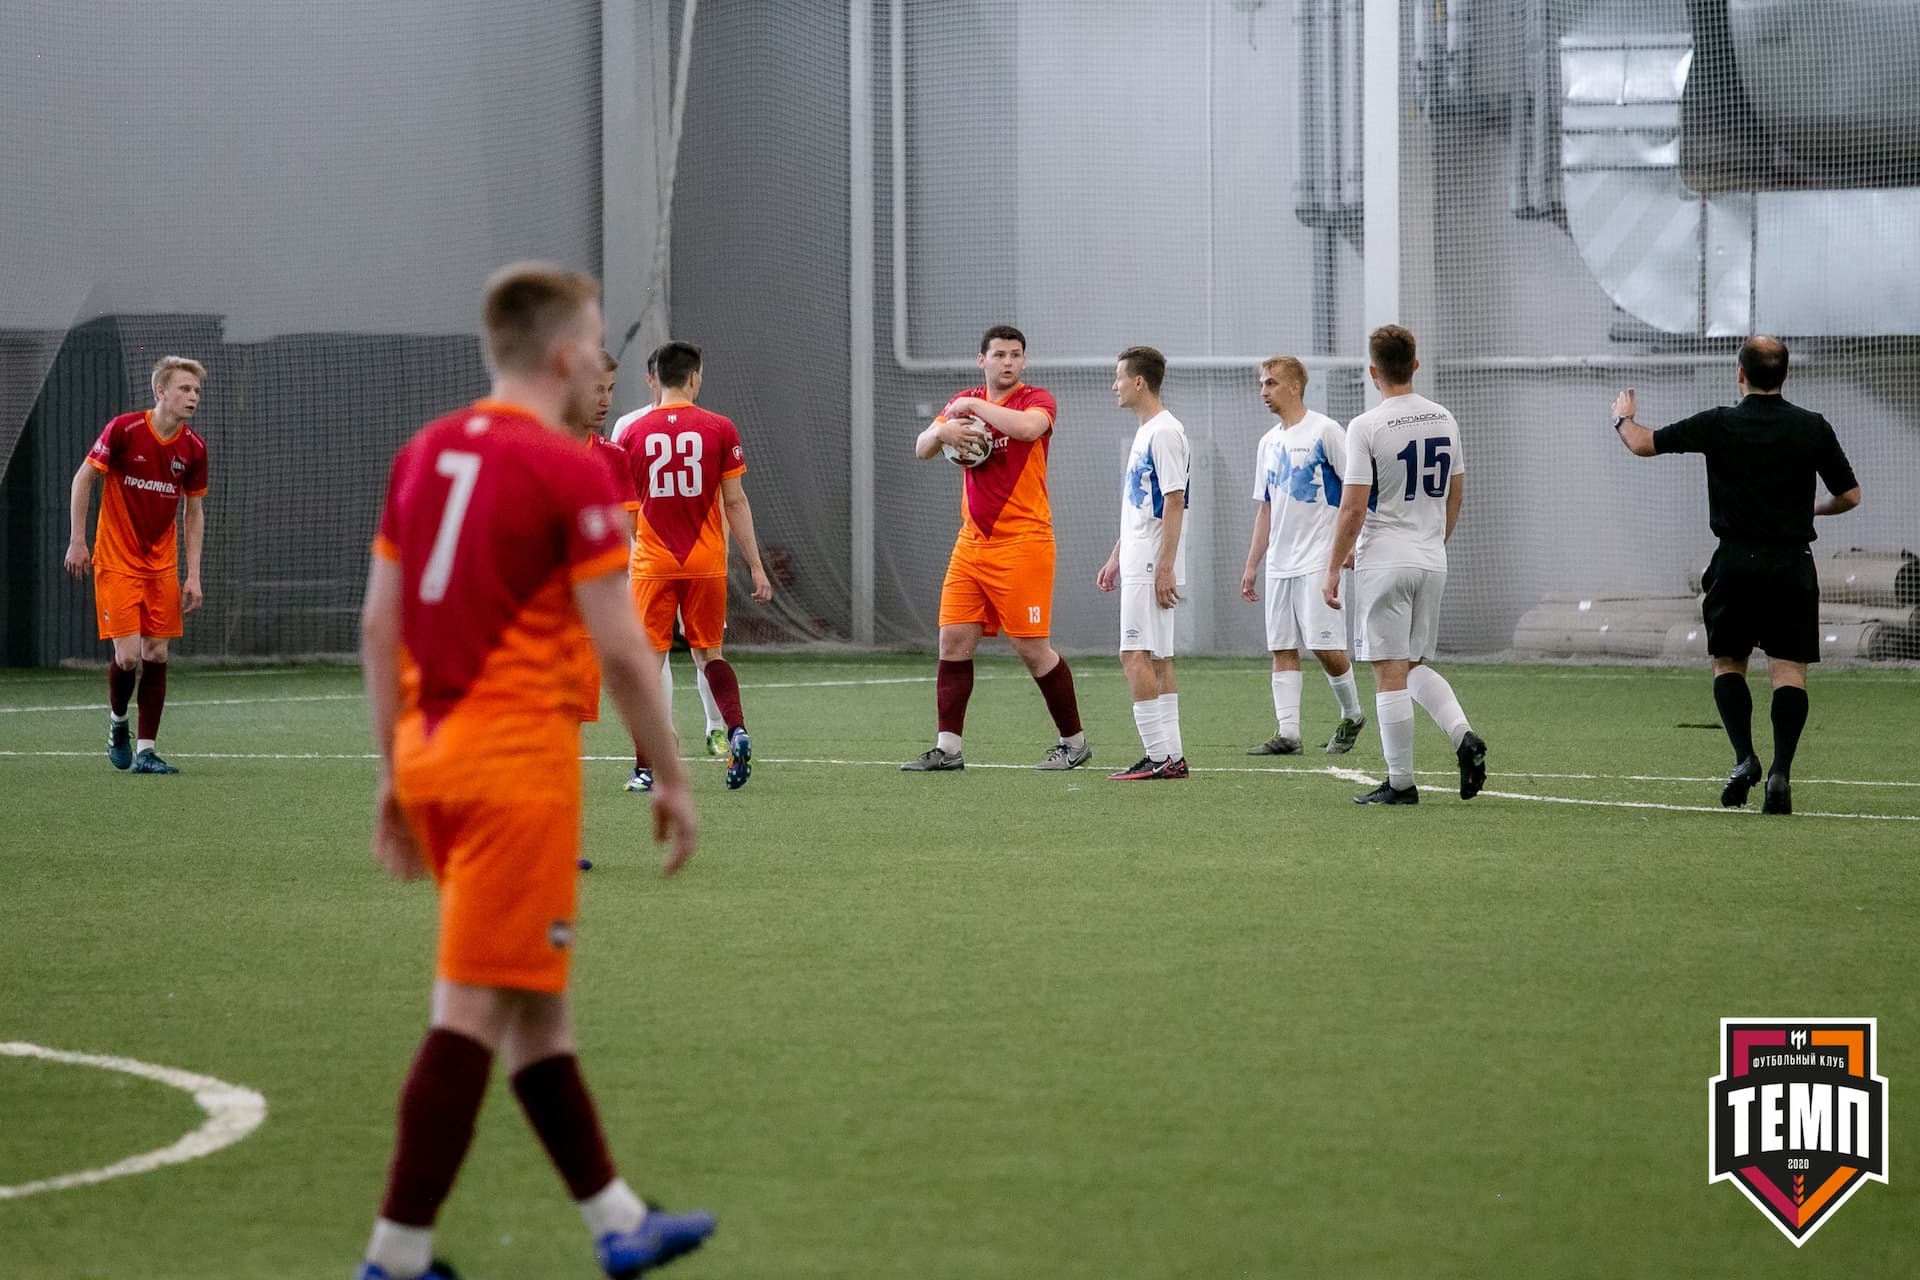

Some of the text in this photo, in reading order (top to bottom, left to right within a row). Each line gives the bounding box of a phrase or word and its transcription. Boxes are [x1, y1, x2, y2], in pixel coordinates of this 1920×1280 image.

[645, 431, 703, 498] 23
[1397, 437, 1450, 501] 15
[418, 449, 482, 605] 7
[1028, 606, 1041, 623] 13
